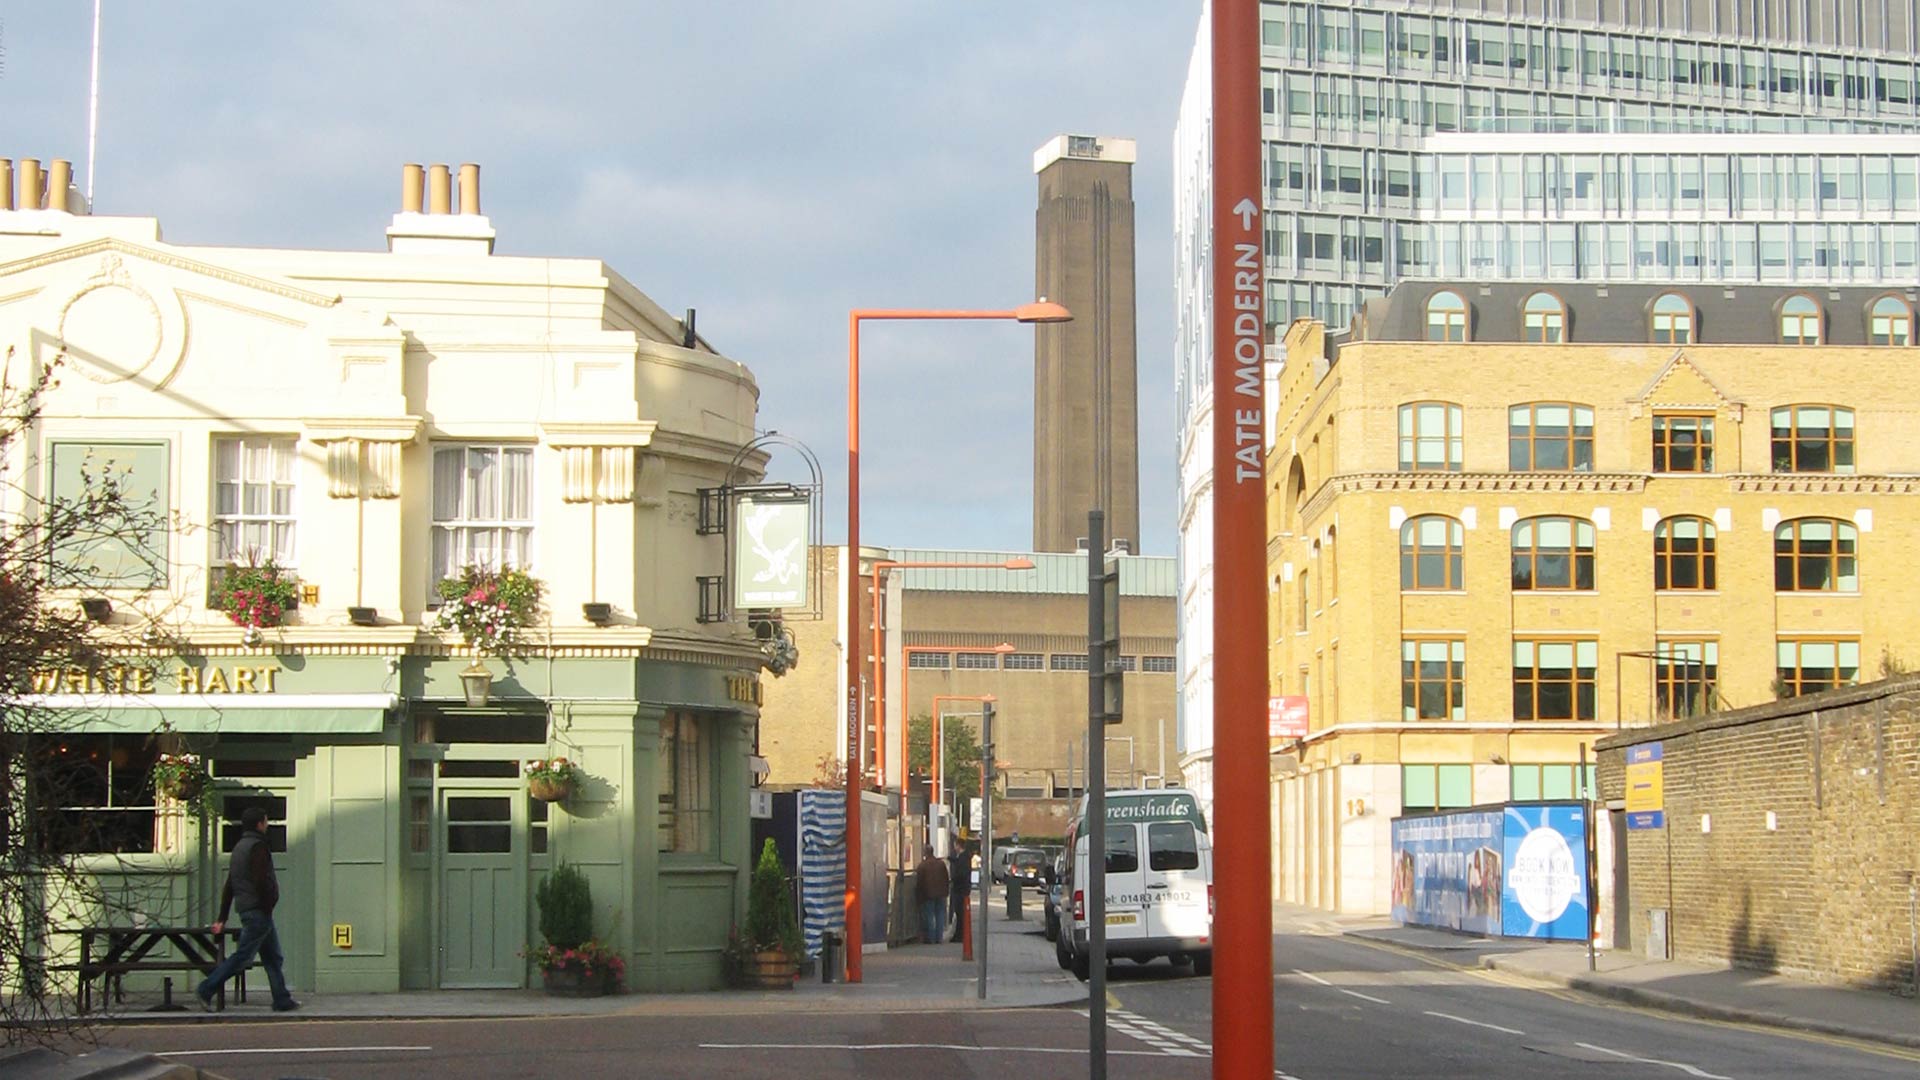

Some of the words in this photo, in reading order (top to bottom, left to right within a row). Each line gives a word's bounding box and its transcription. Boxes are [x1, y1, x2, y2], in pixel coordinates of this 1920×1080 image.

[1234, 243, 1260, 397] MODERN
[1235, 408, 1261, 484] TATE
[175, 666, 282, 694] HART
[727, 677, 755, 701] THE
[849, 697, 857, 738] MODERN
[849, 740, 857, 760] TATE
[1106, 798, 1190, 818] reenshades
[1519, 857, 1545, 872] BOOK
[1548, 857, 1569, 873] NOW
[1120, 894, 1152, 904] 01483
[335, 926, 350, 944] H
